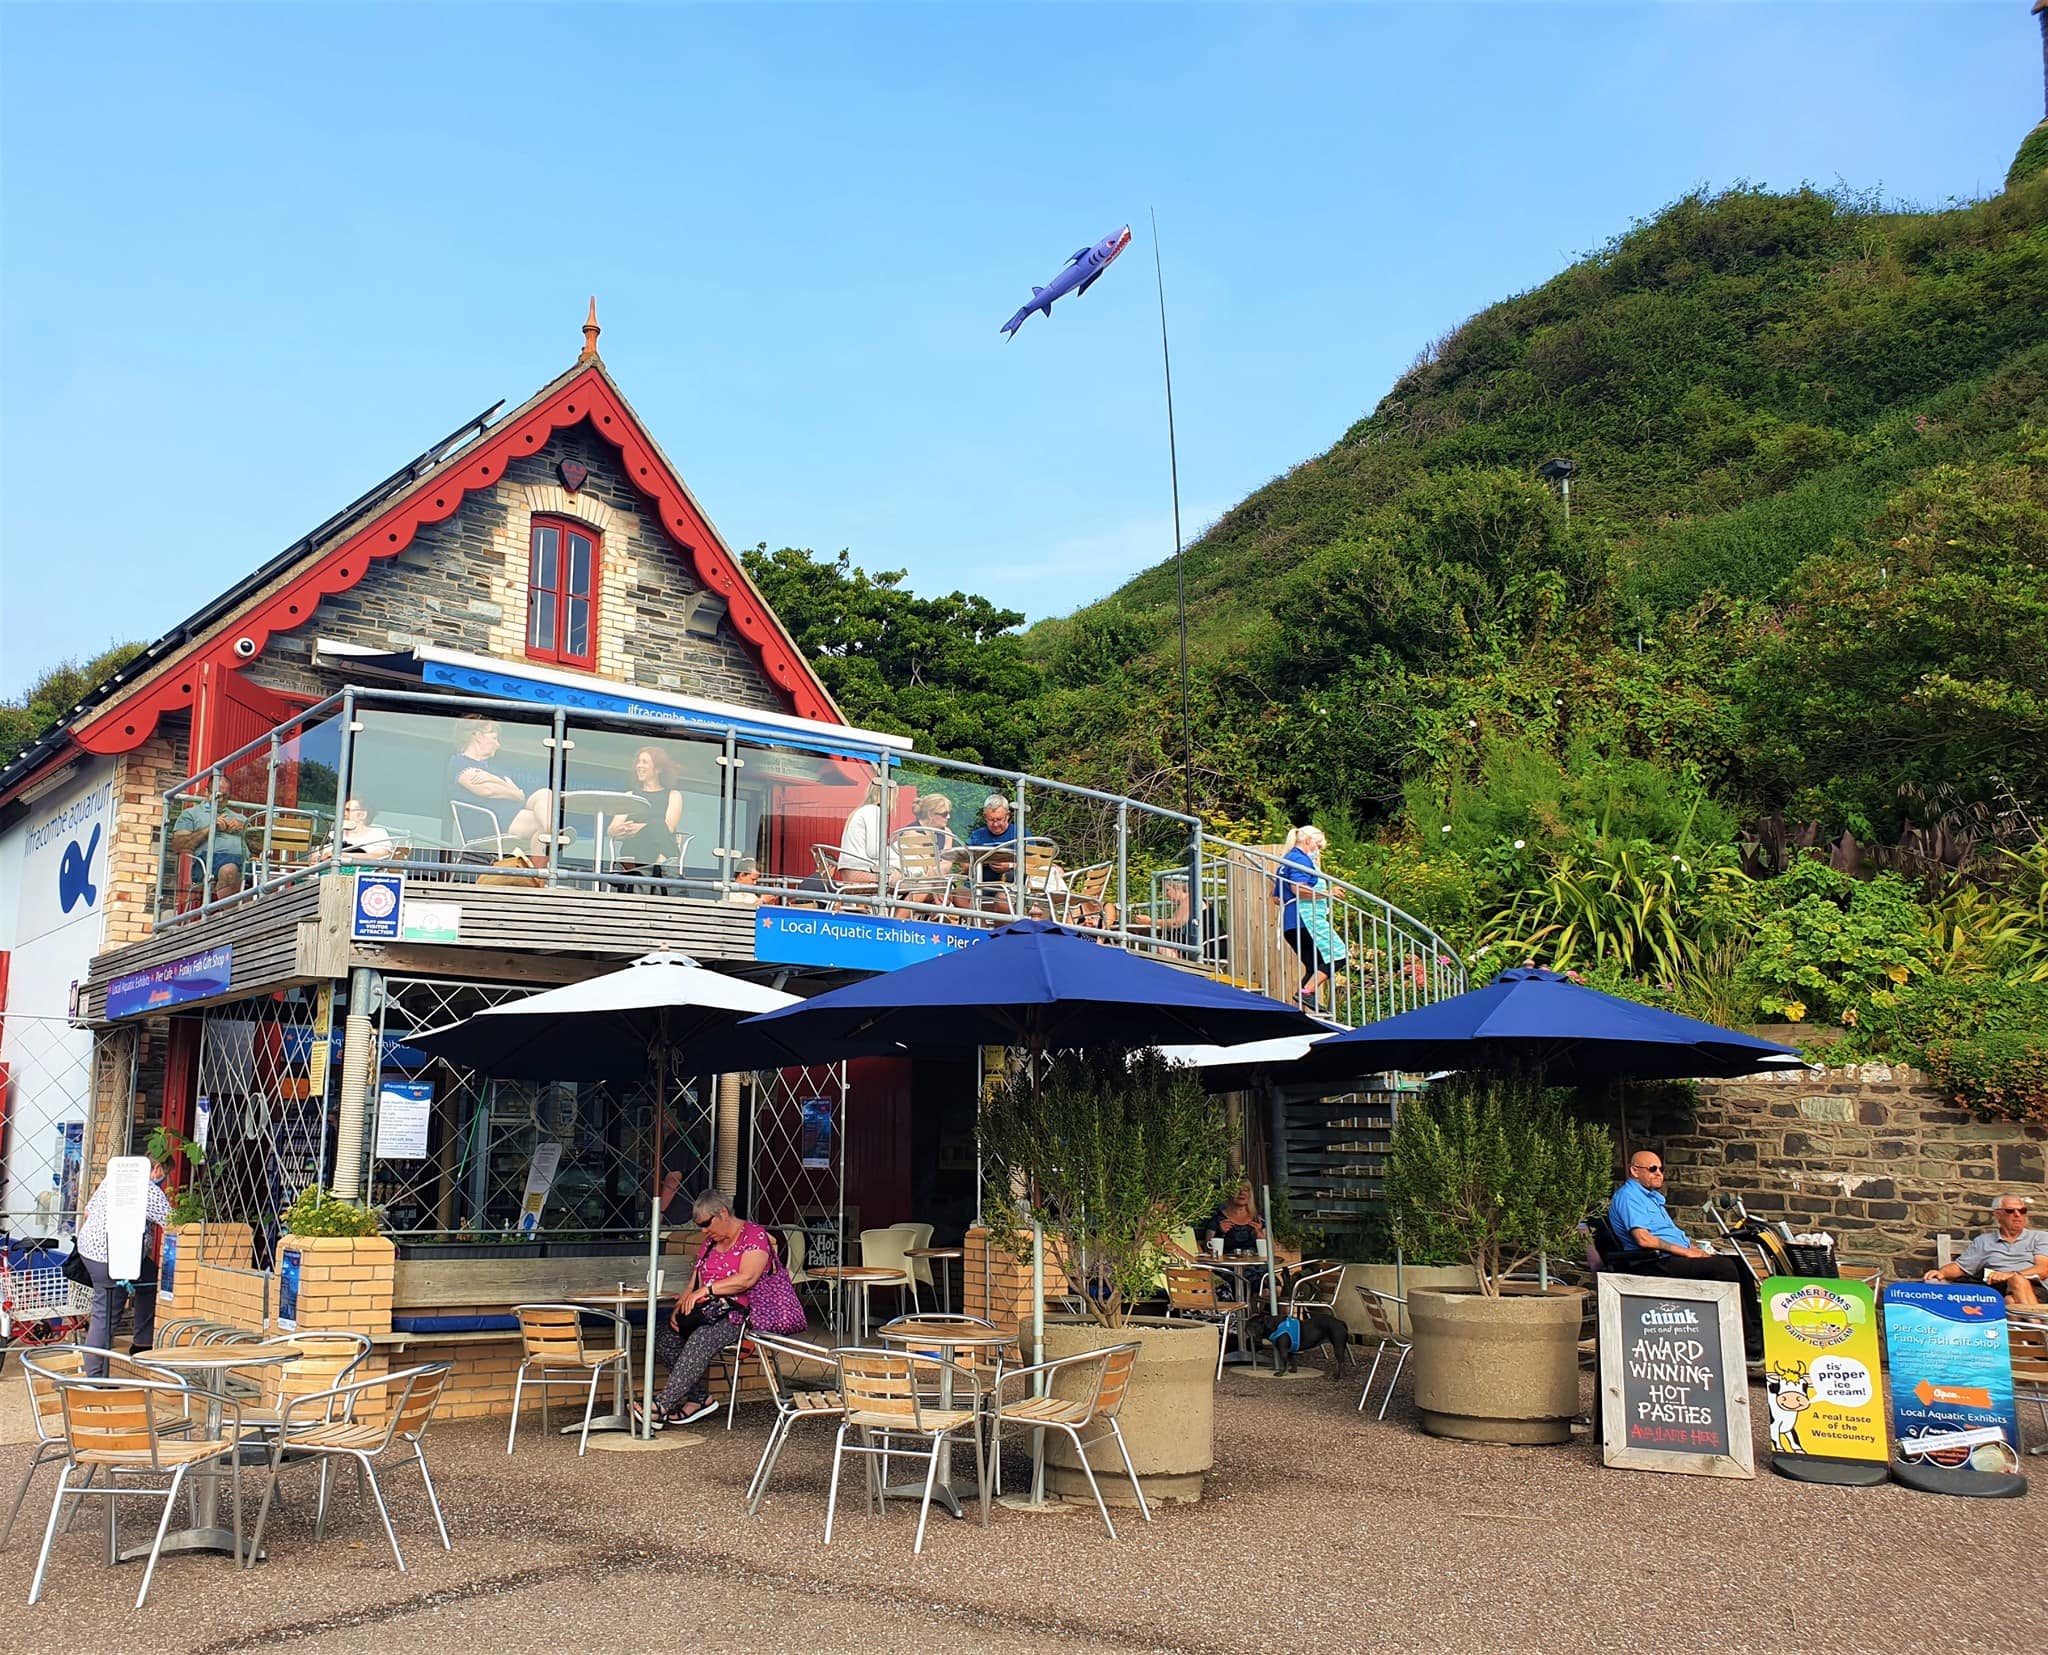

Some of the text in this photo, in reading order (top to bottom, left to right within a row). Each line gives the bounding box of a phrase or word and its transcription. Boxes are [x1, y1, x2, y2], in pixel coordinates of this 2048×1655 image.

[24, 808, 67, 857] ilfracombe
[780, 919, 817, 934] Local
[820, 921, 872, 940] Aquatic
[876, 927, 926, 945] Exhibits
[947, 935, 970, 949] Pier
[112, 982, 122, 995] Local
[155, 971, 164, 983] Pier
[179, 961, 193, 977] Funky
[193, 959, 203, 972] Fish
[203, 956, 213, 970] Gift
[212, 954, 225, 968] Shop
[1780, 1288, 1821, 1309] FARMER
[1890, 1289, 1997, 1304] ilfracombe aquarium
[1641, 1309, 1700, 1325] chunk
[1657, 1325, 1672, 1333] and
[1784, 1324, 1855, 1347] DAIRY ICE CREAM
[1892, 1323, 1912, 1333] Pier
[1894, 1333, 2001, 1350] Funky Fish Gift Shop
[1632, 1337, 1704, 1365] AWARD
[1818, 1371, 1866, 1382] proper
[1834, 1380, 1851, 1388] ice
[1649, 1385, 1690, 1405] HOT
[1827, 1387, 1866, 1396] cream!
[1822, 1413, 1842, 1421] real
[1845, 1415, 1871, 1423] taste
[1900, 1408, 2008, 1424] Local Aquatic Exhibits
[1842, 1423, 1858, 1431] the
[1811, 1429, 1875, 1443] Westcountry
